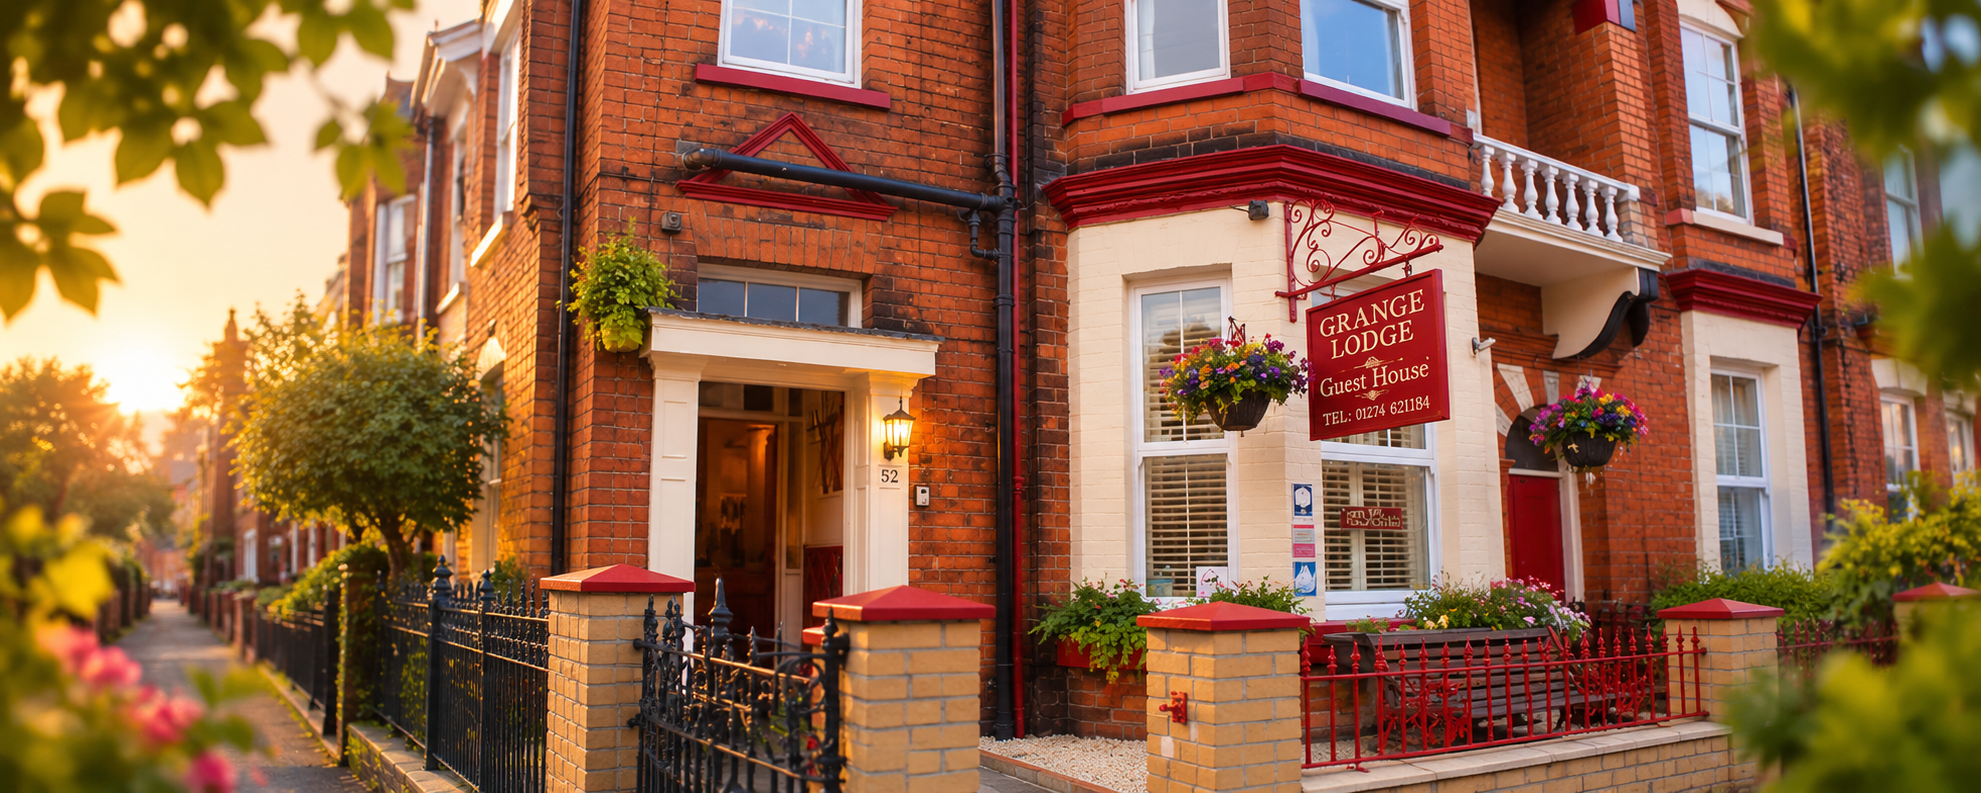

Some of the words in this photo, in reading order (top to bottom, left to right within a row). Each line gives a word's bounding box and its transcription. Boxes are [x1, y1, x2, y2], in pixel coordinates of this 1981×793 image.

[1320, 289, 1425, 337] GRANGE
[1330, 319, 1414, 360] LODGE
[1320, 373, 1367, 398] Guest
[1372, 363, 1429, 388] House
[1322, 411, 1352, 426] TEL:
[1355, 403, 1386, 421] 01274
[1390, 395, 1431, 415] 621184
[881, 469, 899, 483] 52
